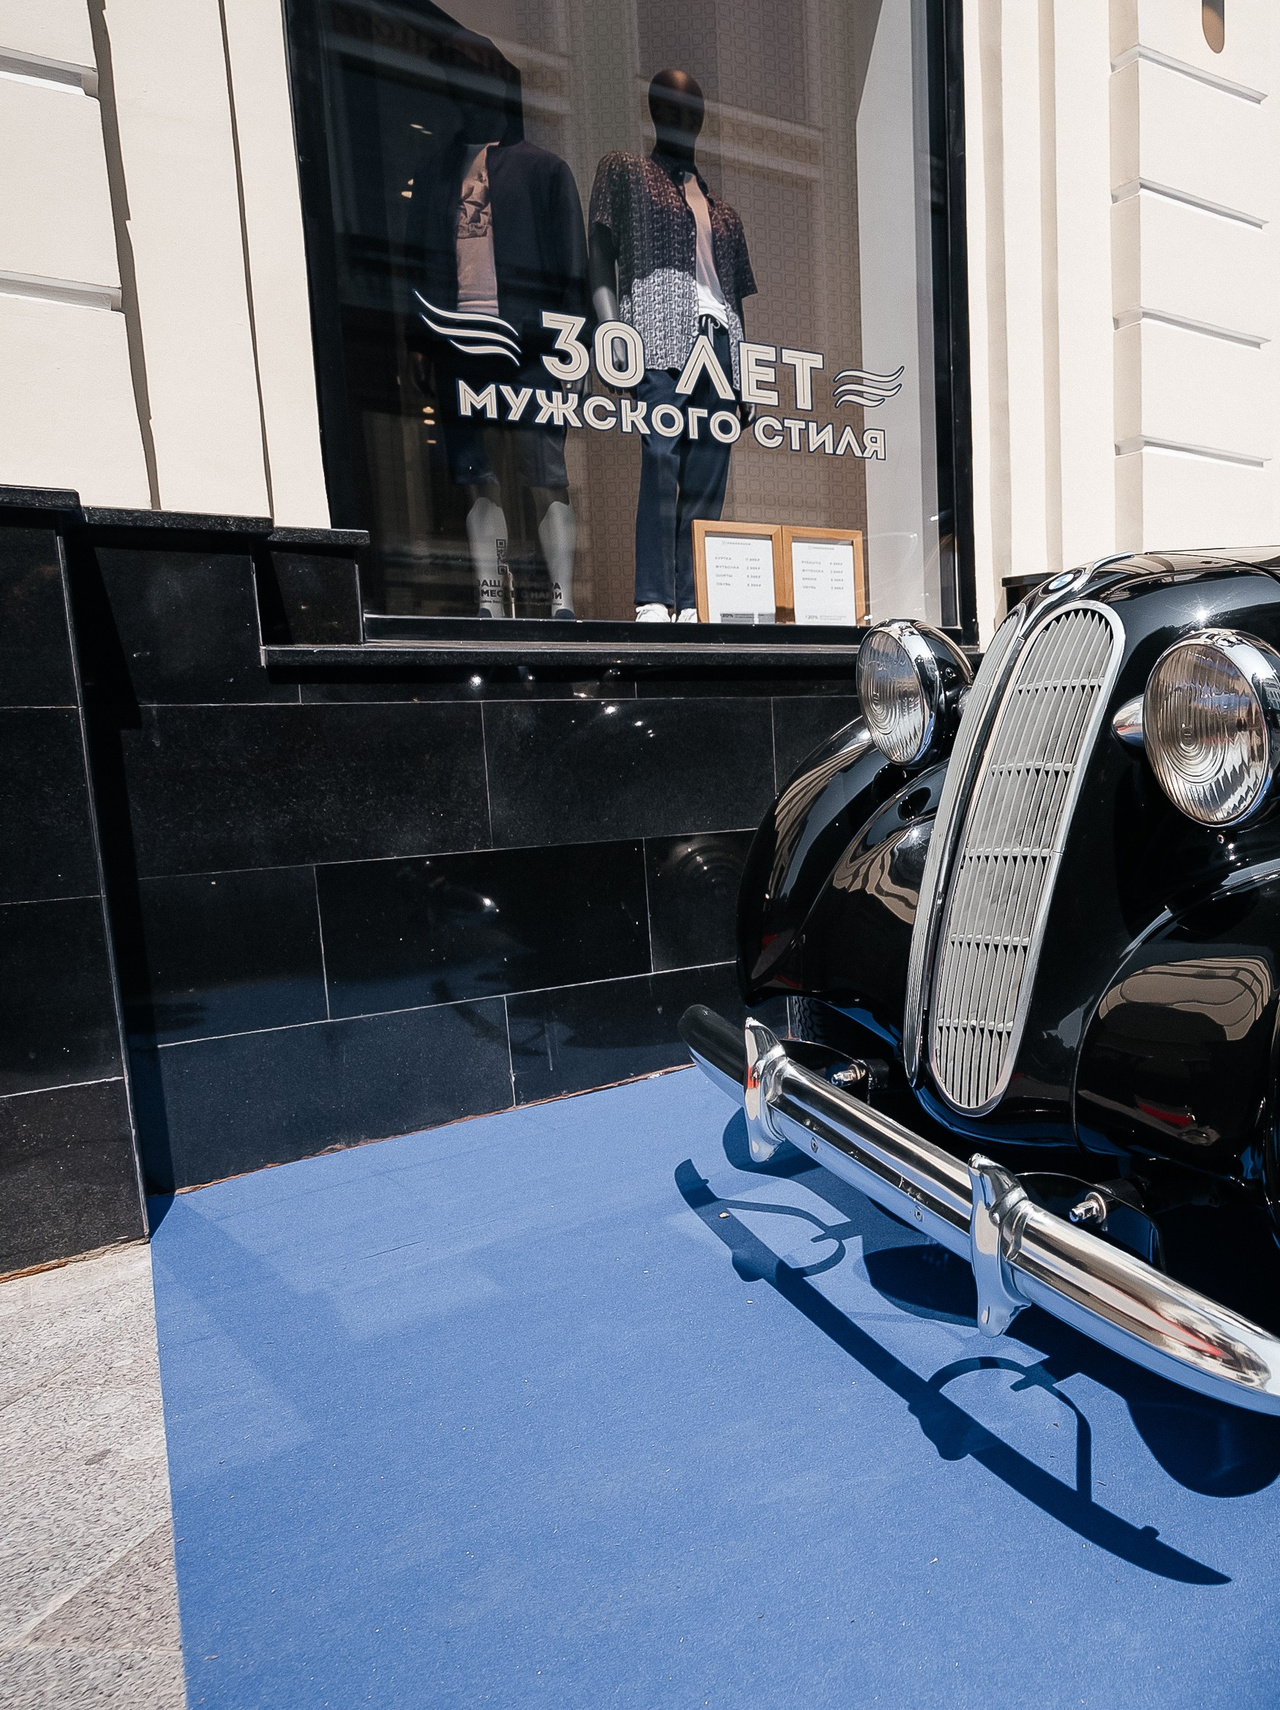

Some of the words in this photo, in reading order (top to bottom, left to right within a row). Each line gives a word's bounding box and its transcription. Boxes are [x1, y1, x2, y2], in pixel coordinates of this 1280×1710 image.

[540, 310, 645, 388] 30
[675, 334, 825, 411] ЛЕТ
[456, 378, 742, 446] МУЖСКОГО
[753, 415, 887, 461] СТИЛЯ
